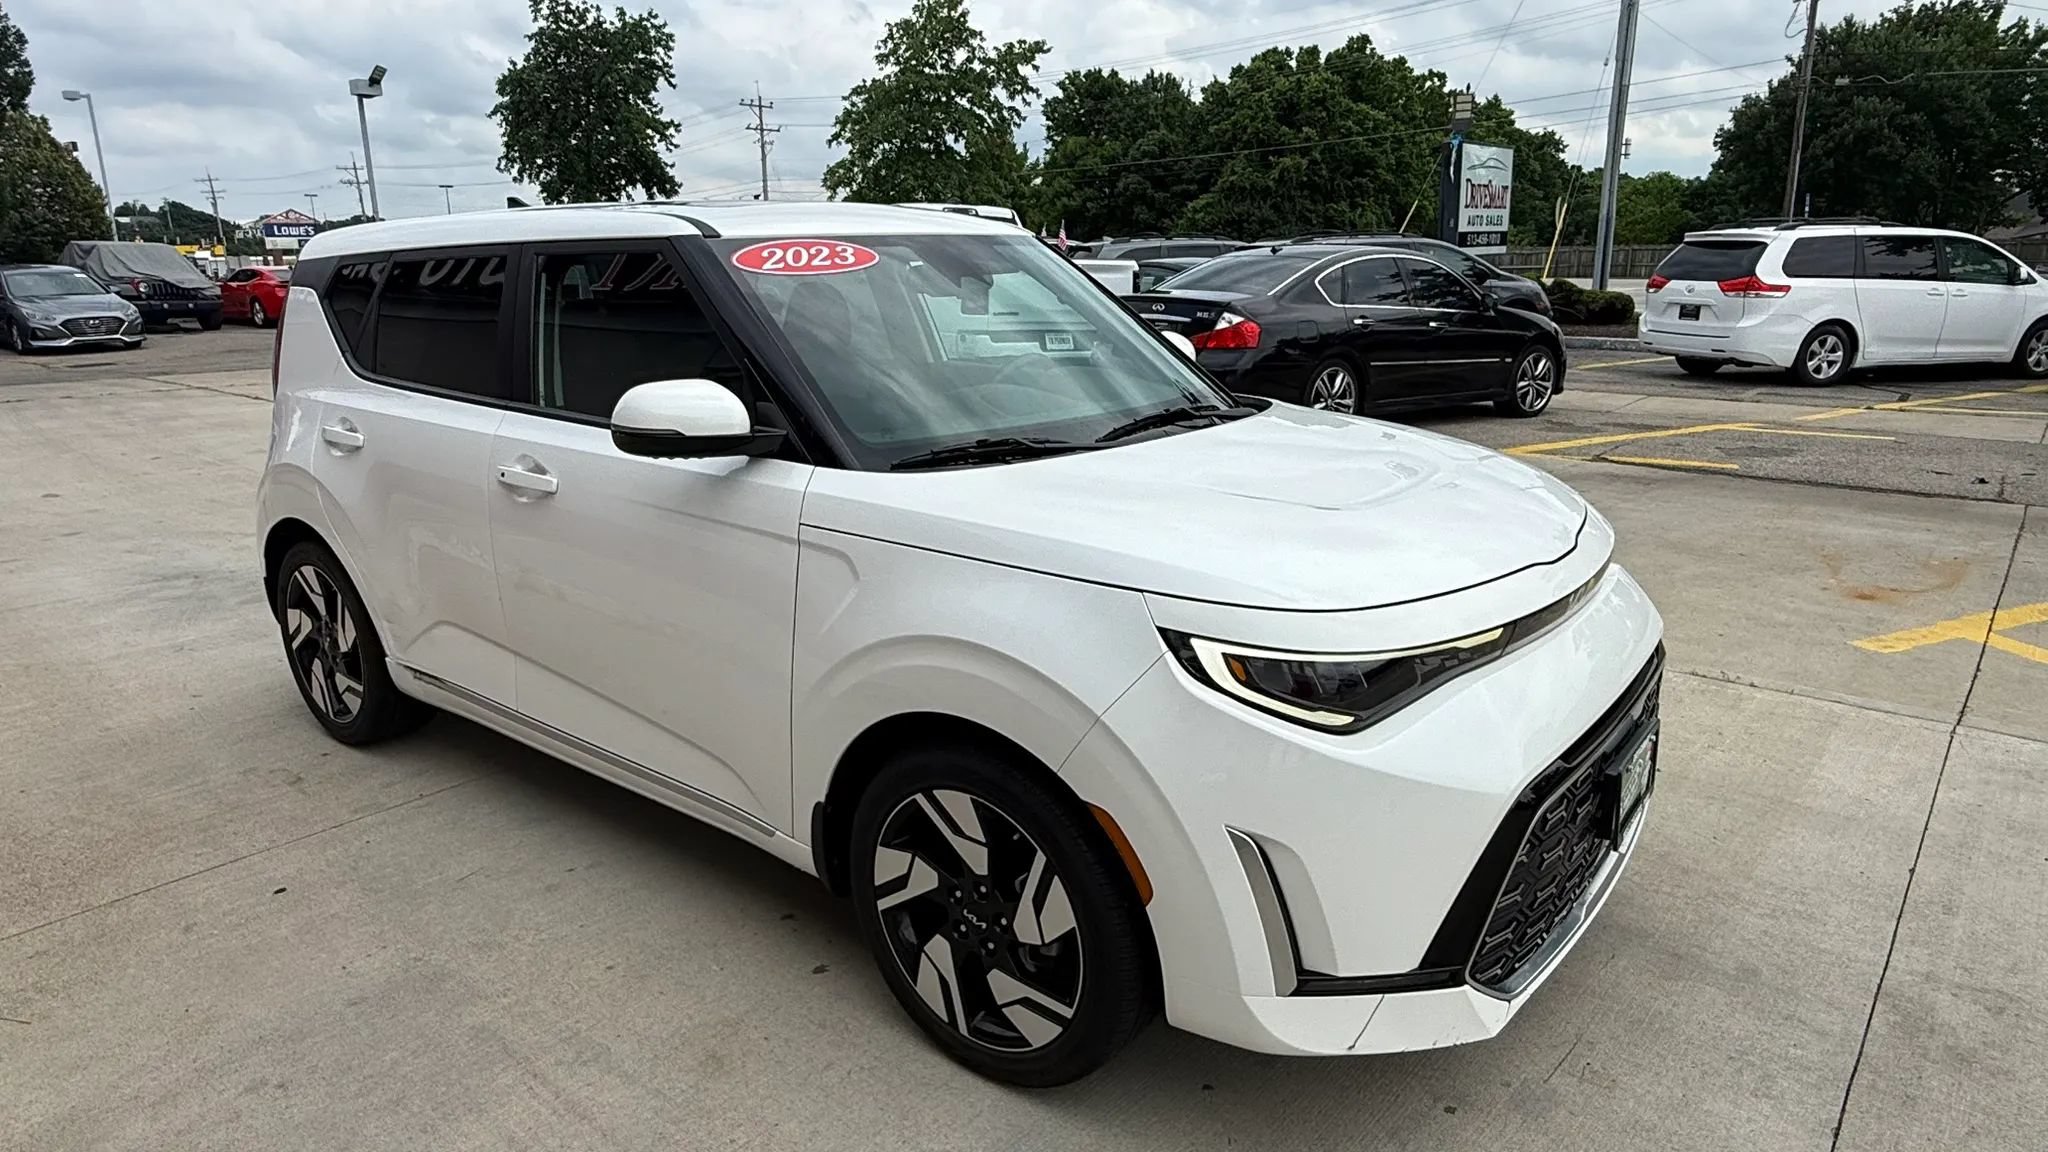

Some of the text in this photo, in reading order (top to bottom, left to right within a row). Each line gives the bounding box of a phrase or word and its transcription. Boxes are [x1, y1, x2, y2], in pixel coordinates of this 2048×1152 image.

[1467, 214, 1504, 226] AUTO SALES
[273, 225, 316, 236] LOWE'S
[761, 246, 856, 270] 2023
